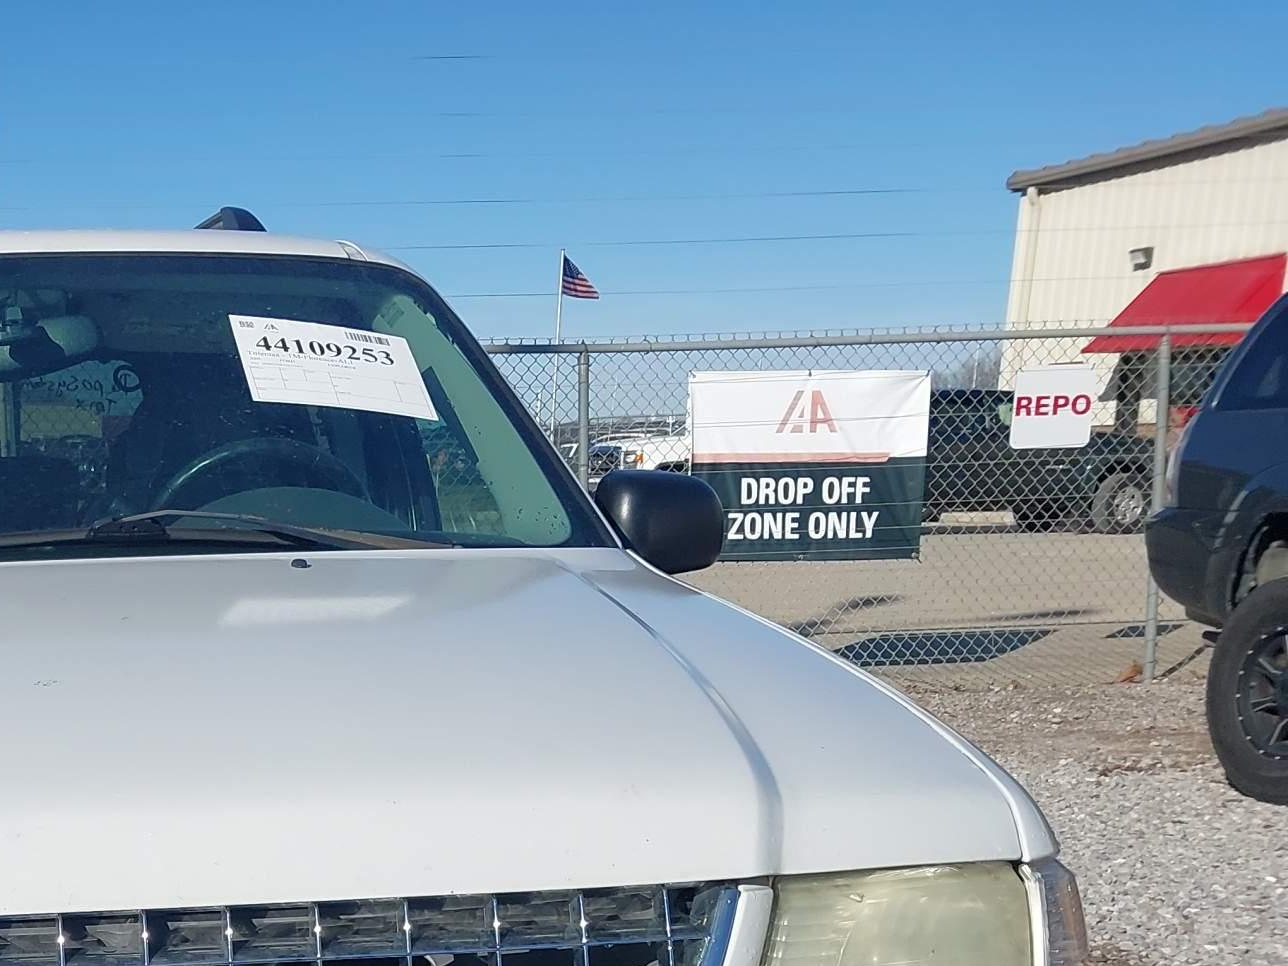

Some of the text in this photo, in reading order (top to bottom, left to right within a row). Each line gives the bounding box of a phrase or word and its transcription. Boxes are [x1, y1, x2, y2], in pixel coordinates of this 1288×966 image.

[255, 335, 394, 365] 44109253
[1015, 394, 1092, 416] REPO
[741, 476, 871, 505] DROP OFF
[727, 511, 880, 540] ZONE ONLY
